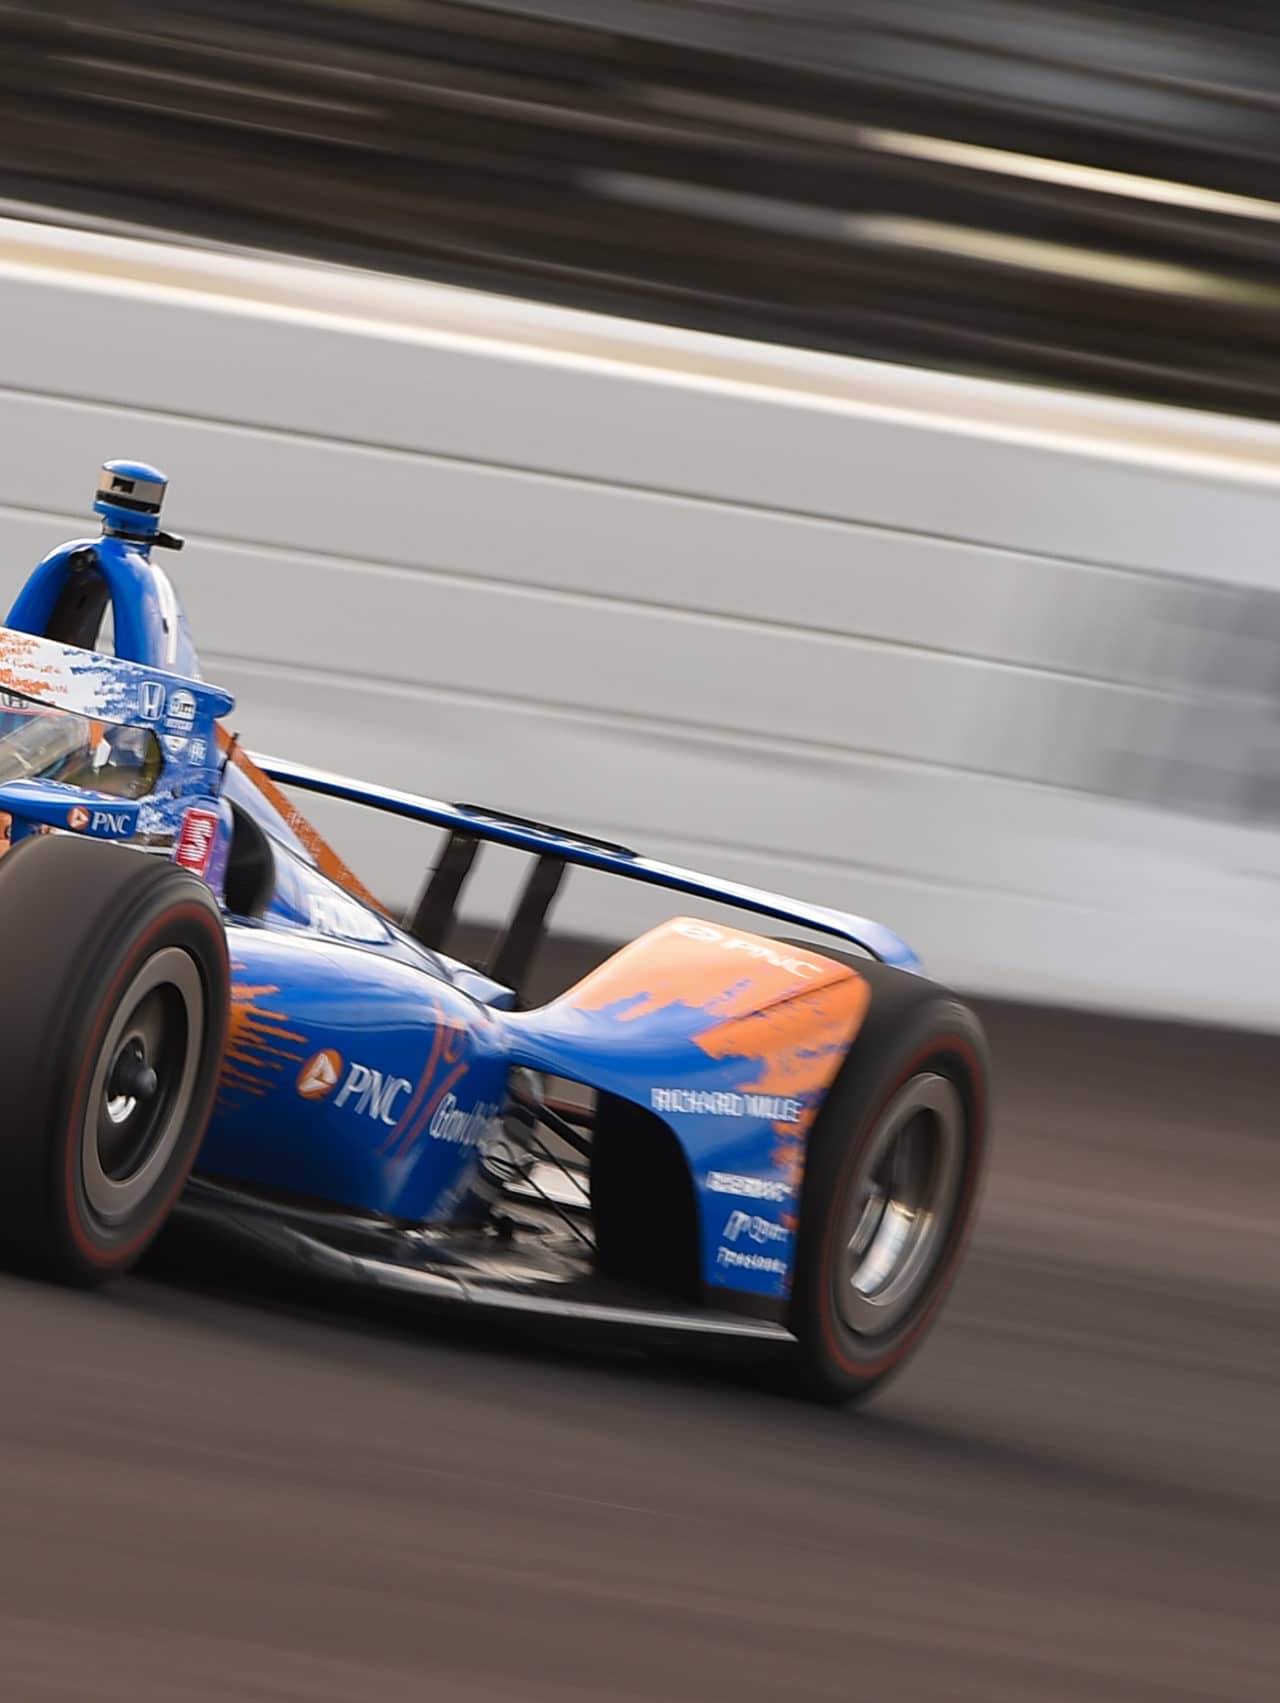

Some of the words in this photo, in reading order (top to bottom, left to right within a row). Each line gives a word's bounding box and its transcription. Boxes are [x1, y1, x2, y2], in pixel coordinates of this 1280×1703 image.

[91, 811, 131, 835] PNC
[333, 1061, 413, 1126] PNC
[651, 1087, 744, 1117] RICHARD
